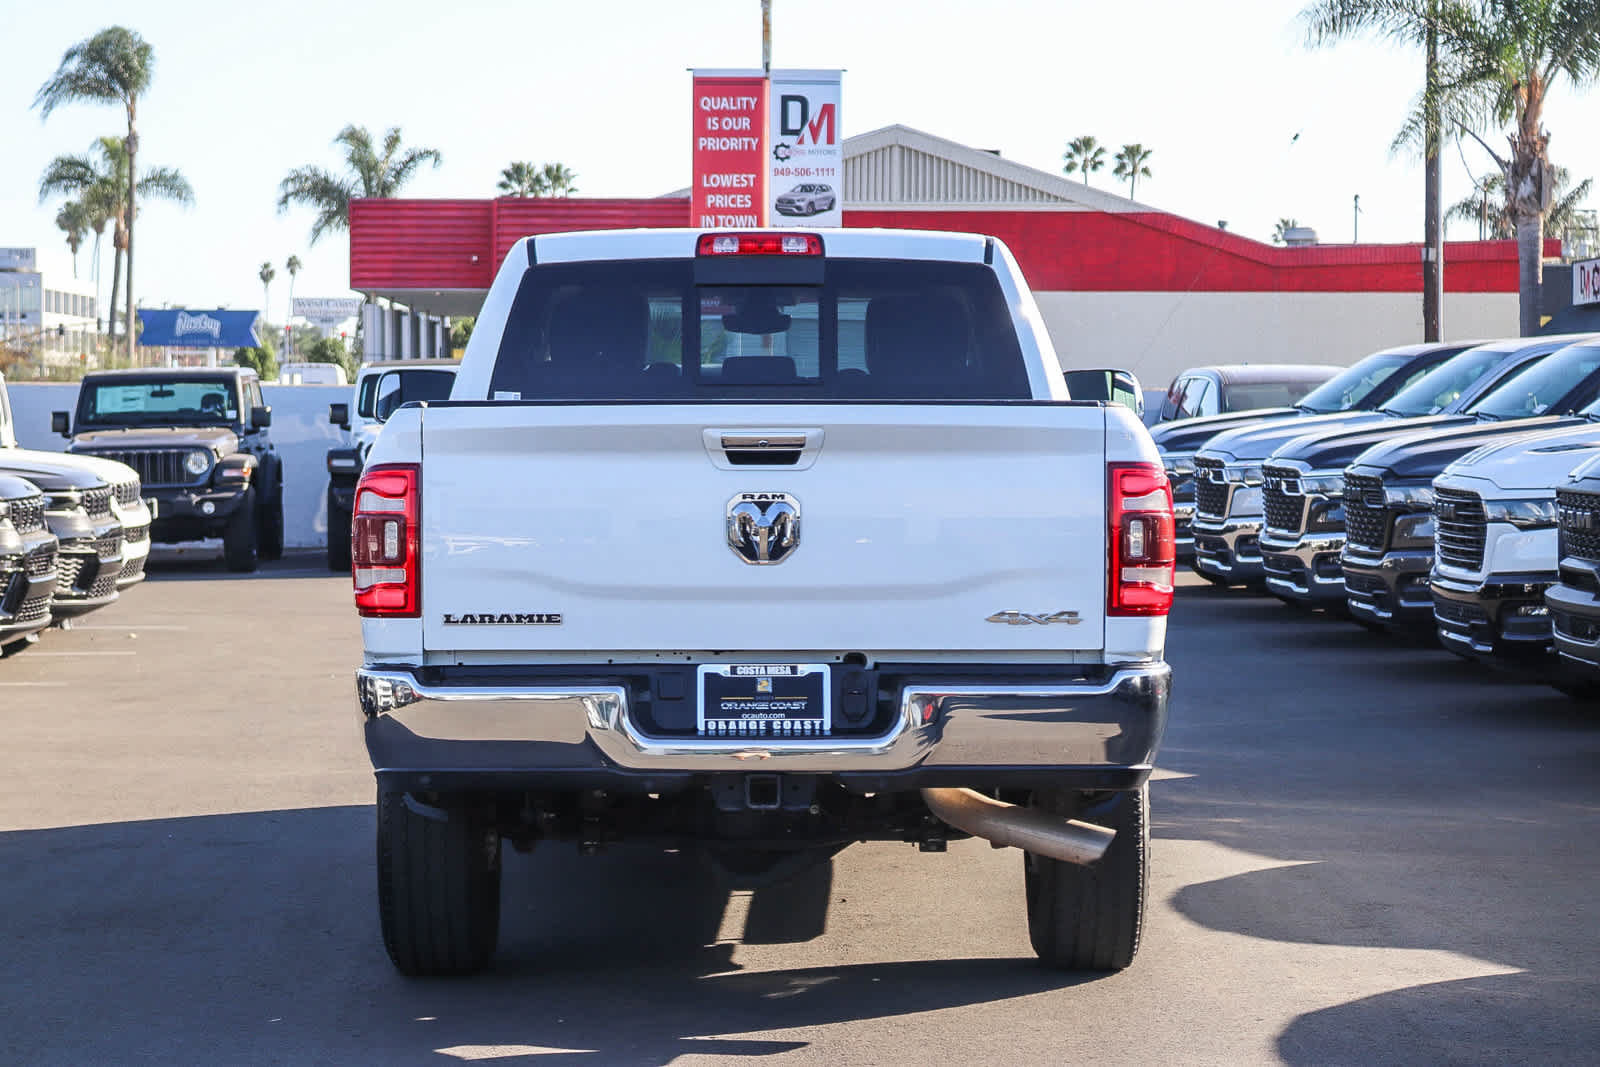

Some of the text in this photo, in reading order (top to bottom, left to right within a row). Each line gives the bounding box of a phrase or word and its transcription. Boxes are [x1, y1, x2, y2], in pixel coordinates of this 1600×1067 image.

[700, 97, 757, 111] QUALITY
[707, 117, 751, 130] IS OUR
[698, 137, 759, 151] PRIORITY
[773, 167, 835, 177] 949-506-1111
[703, 174, 756, 188] LOWEST
[706, 194, 752, 209] PRICES
[701, 215, 757, 228] IN TOWN
[443, 613, 561, 624] LARAMIE
[736, 666, 792, 675] COSTA MESA
[720, 701, 808, 710] ORANGE COAST
[707, 720, 822, 730] ORANGE COAST
